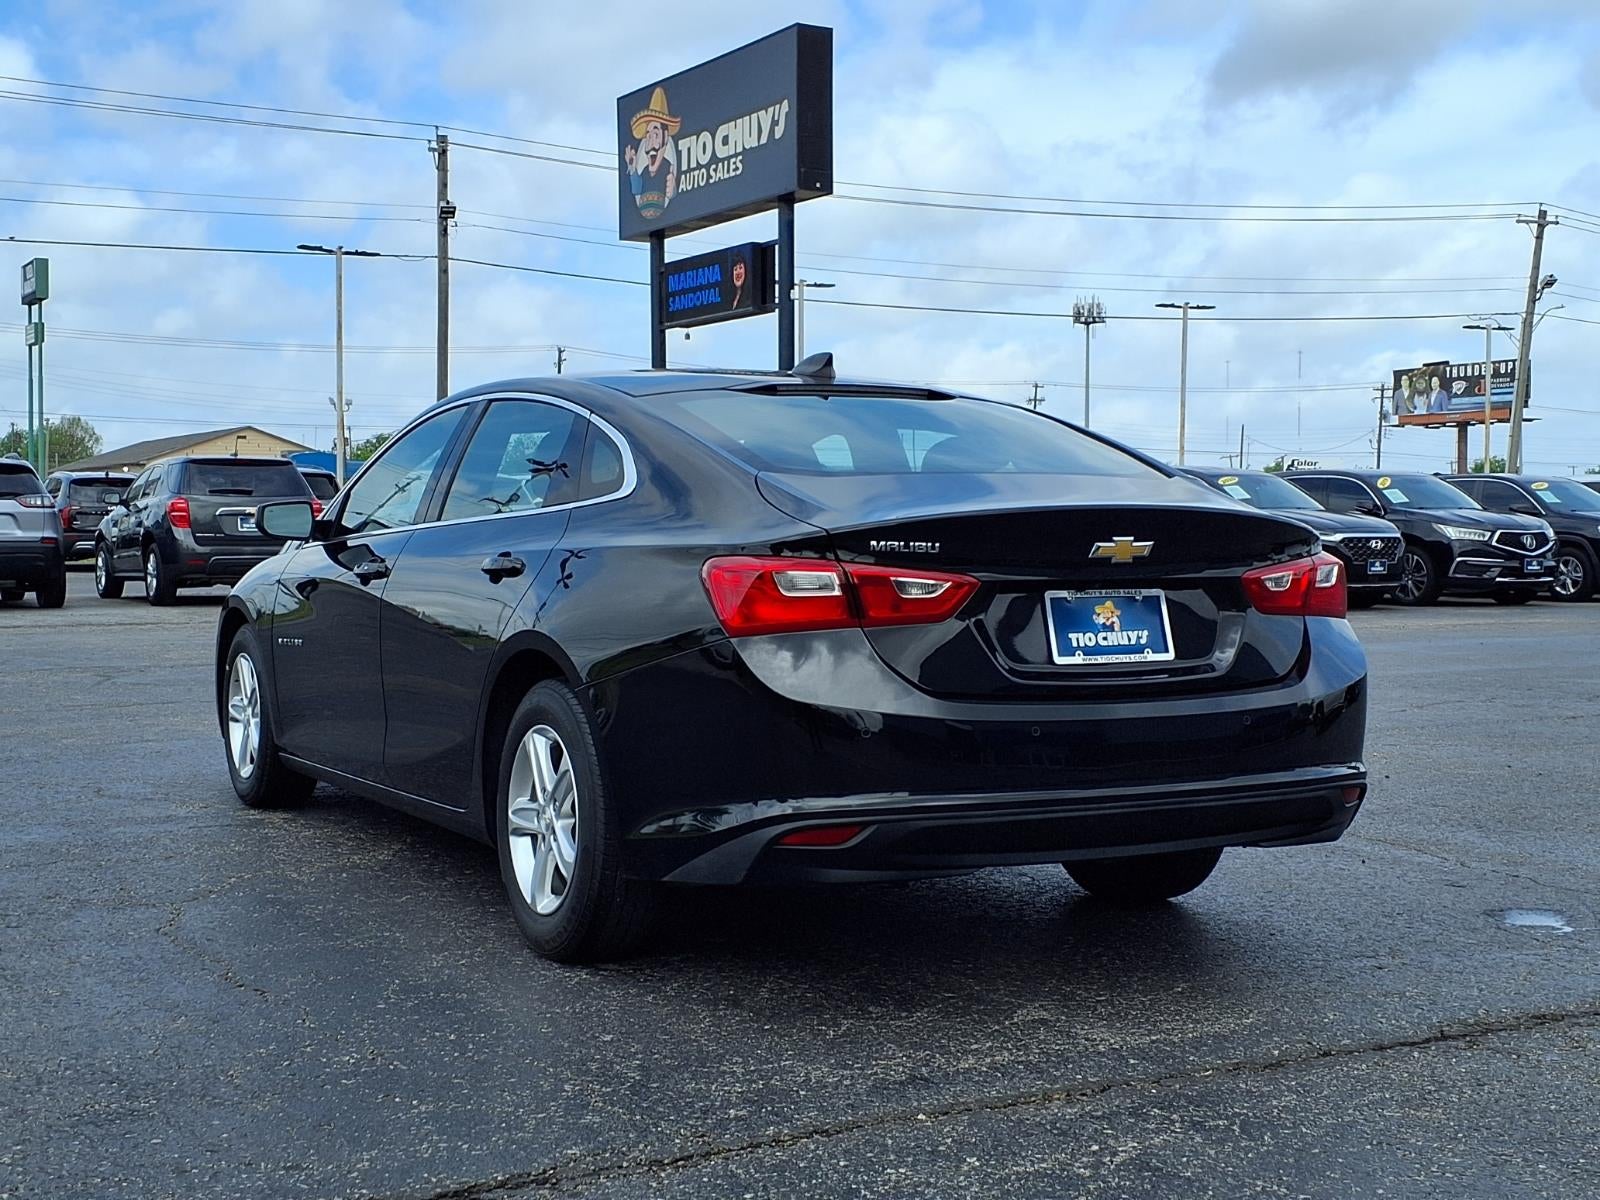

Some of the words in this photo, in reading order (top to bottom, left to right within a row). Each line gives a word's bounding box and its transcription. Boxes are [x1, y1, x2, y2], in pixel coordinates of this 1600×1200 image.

[678, 131, 713, 171] TIO
[714, 99, 790, 158] CHUY'S
[678, 170, 707, 193] AUTO
[709, 156, 743, 184] SALES
[668, 264, 722, 292] MARIANA
[668, 288, 721, 312] SANDOVAL
[870, 540, 940, 553] MALIBU
[1068, 632, 1096, 647] TIO
[1097, 630, 1149, 646] CHUY'S
[1082, 655, 1148, 663] WWW.TIOCHUYS.COM
